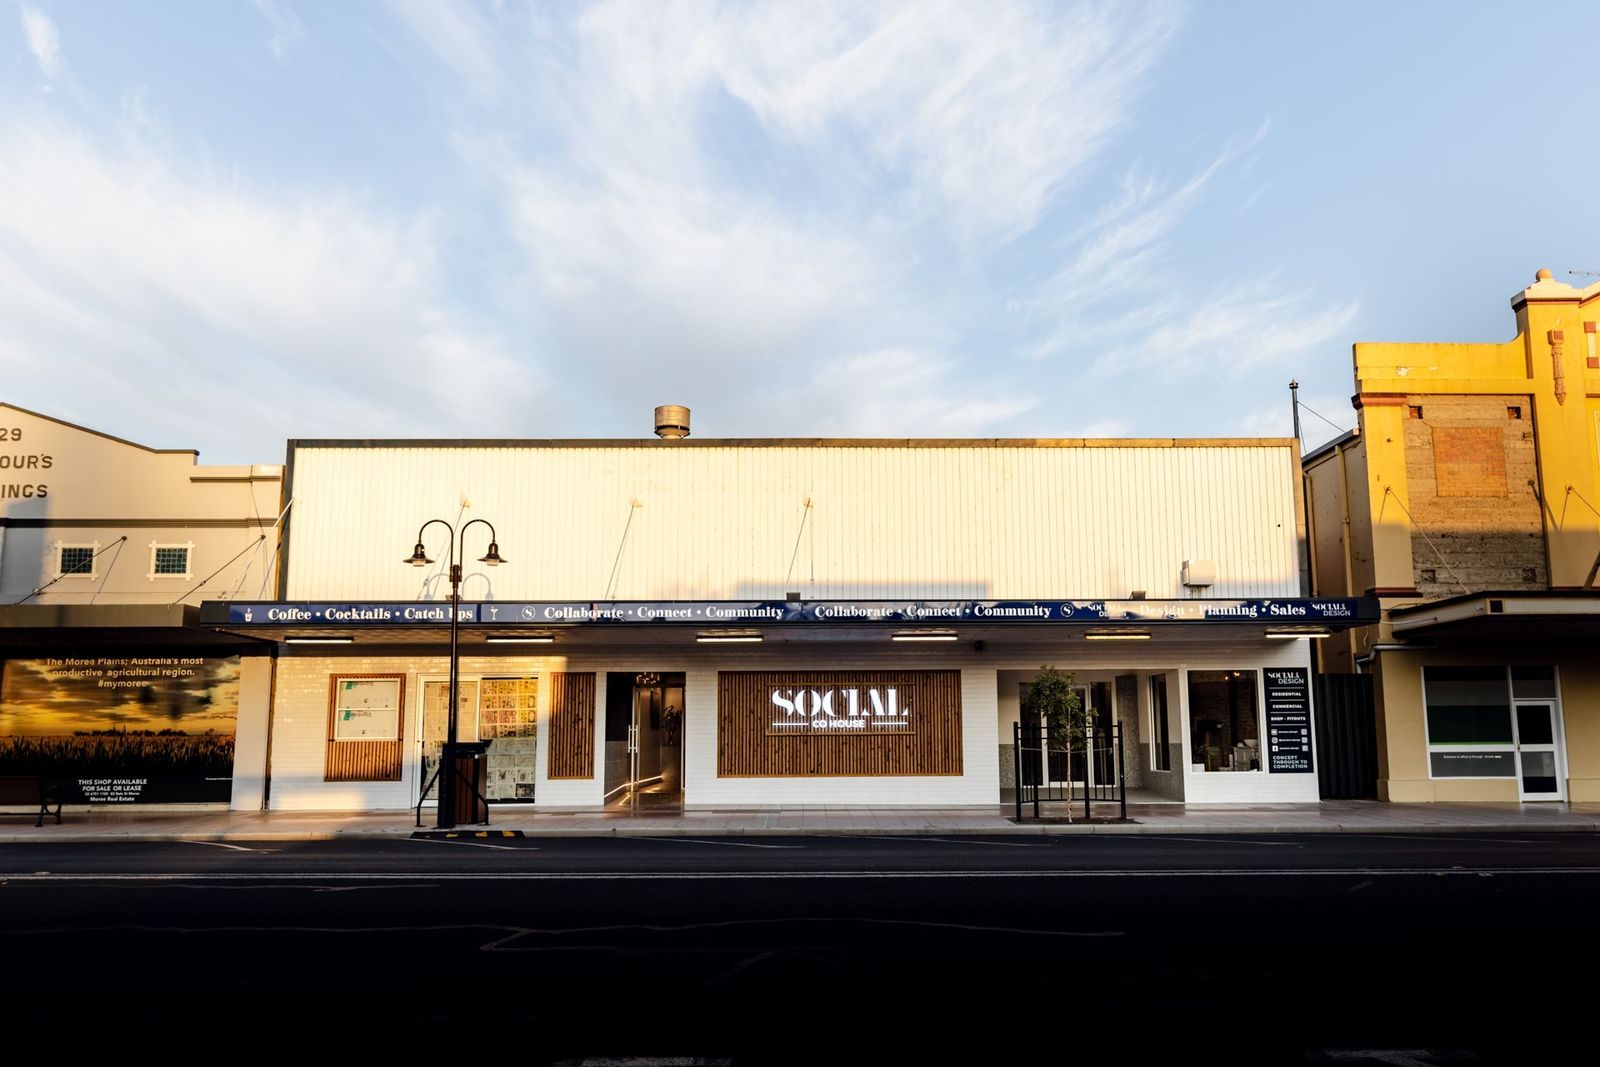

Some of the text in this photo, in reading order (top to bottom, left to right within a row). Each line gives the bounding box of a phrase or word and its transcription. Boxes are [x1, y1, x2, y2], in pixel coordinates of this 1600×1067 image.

[0, 428, 22, 441] 29
[1, 484, 48, 498] INGS
[268, 607, 312, 620] Coffee
[325, 607, 391, 620] Cocktails
[404, 607, 444, 620] Catch
[544, 606, 784, 619] Collaborate Connect Community
[814, 604, 1051, 618] Collaborate Connect Community
[1199, 604, 1258, 617] Planning
[1270, 603, 1306, 616] Sales
[131, 657, 178, 665] Australia's
[180, 657, 204, 665] most
[52, 667, 195, 678] productive agricultural region.
[98, 680, 147, 689] #mymoree
[771, 688, 909, 717] SOCIAL
[812, 719, 866, 728] CO HOUSE
